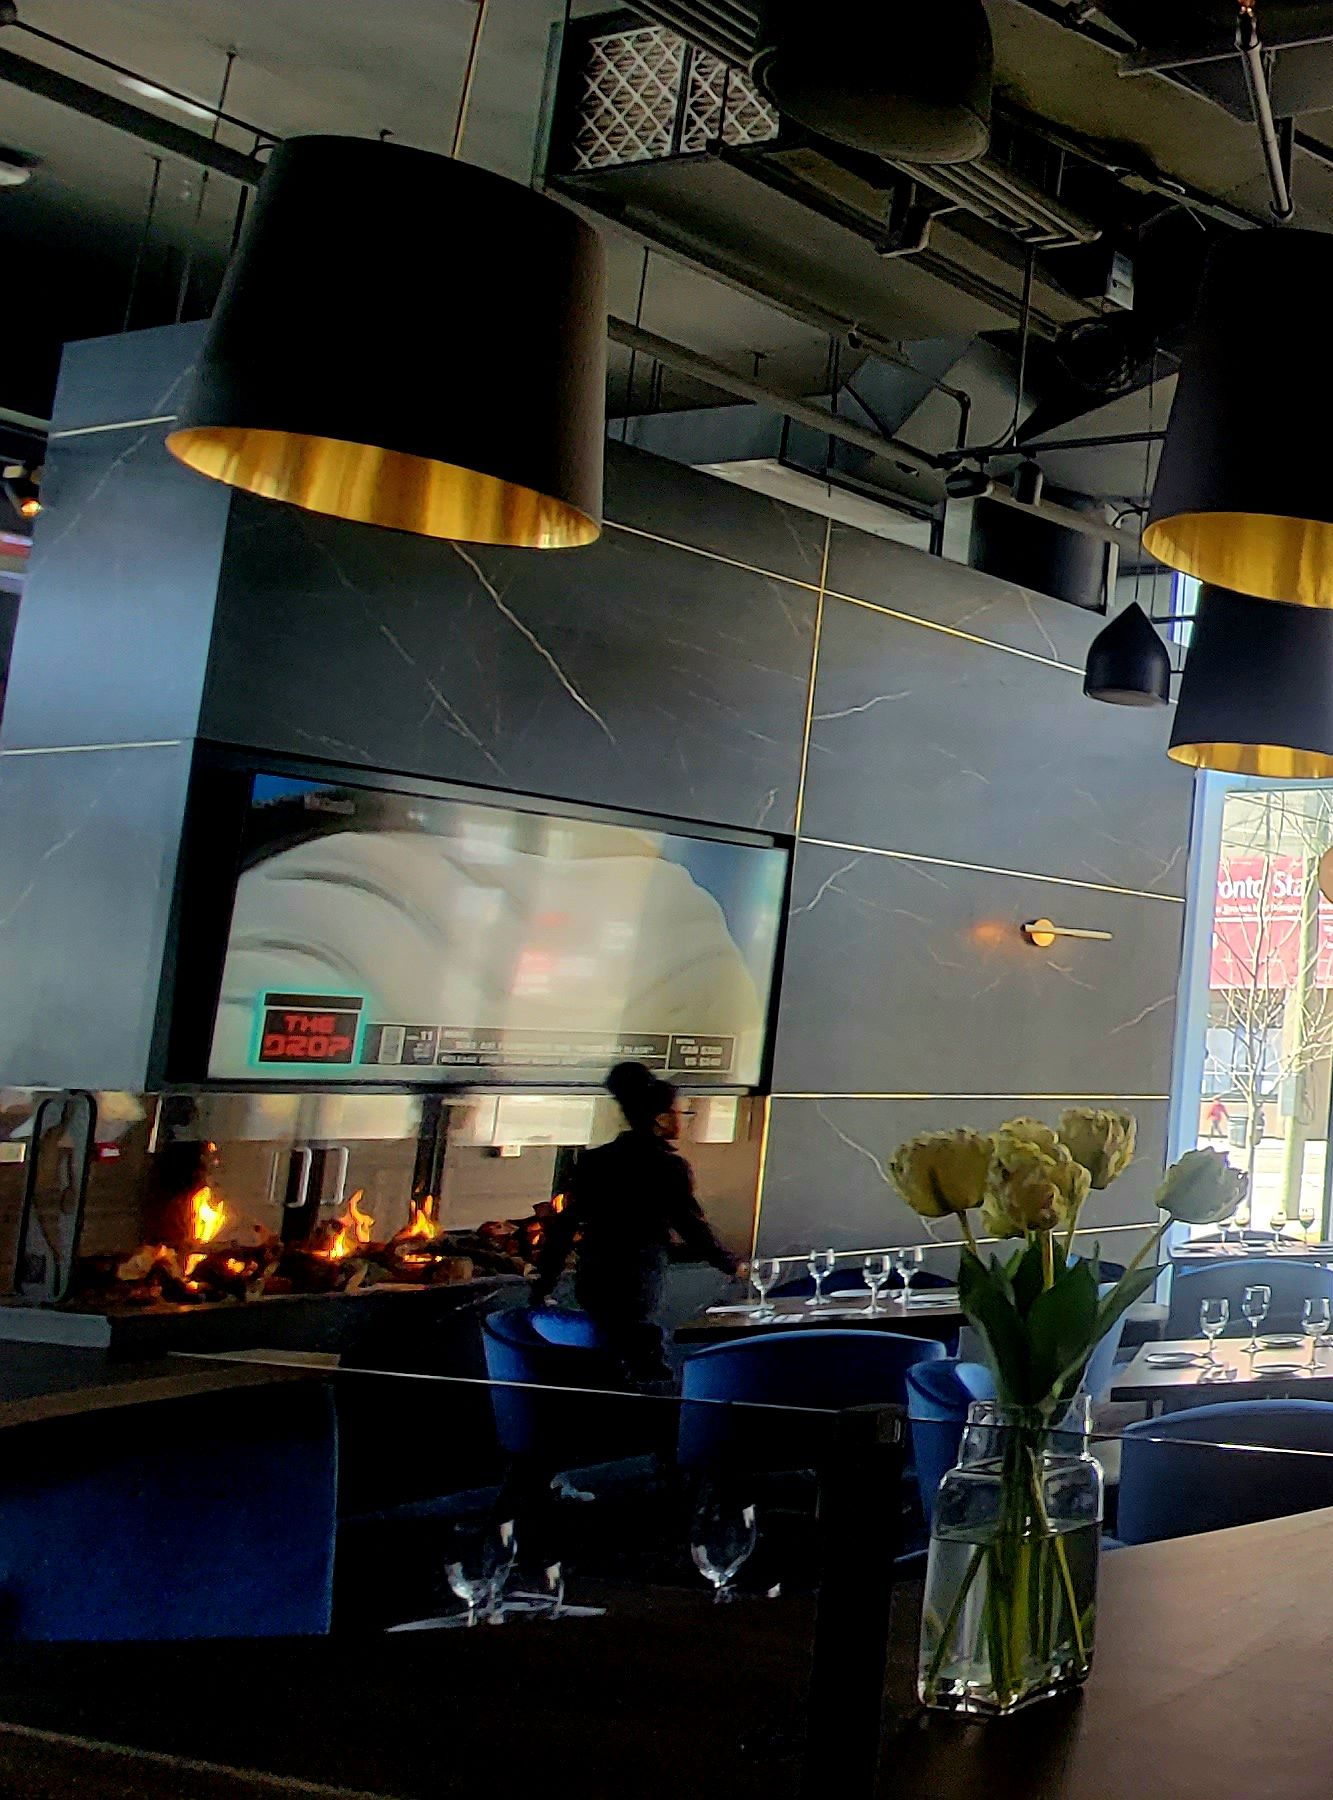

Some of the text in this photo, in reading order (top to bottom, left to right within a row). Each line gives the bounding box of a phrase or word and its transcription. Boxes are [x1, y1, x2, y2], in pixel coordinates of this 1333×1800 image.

[1272, 872, 1303, 898] Sta
[283, 1013, 337, 1033] THE
[263, 1034, 350, 1057] DROP
